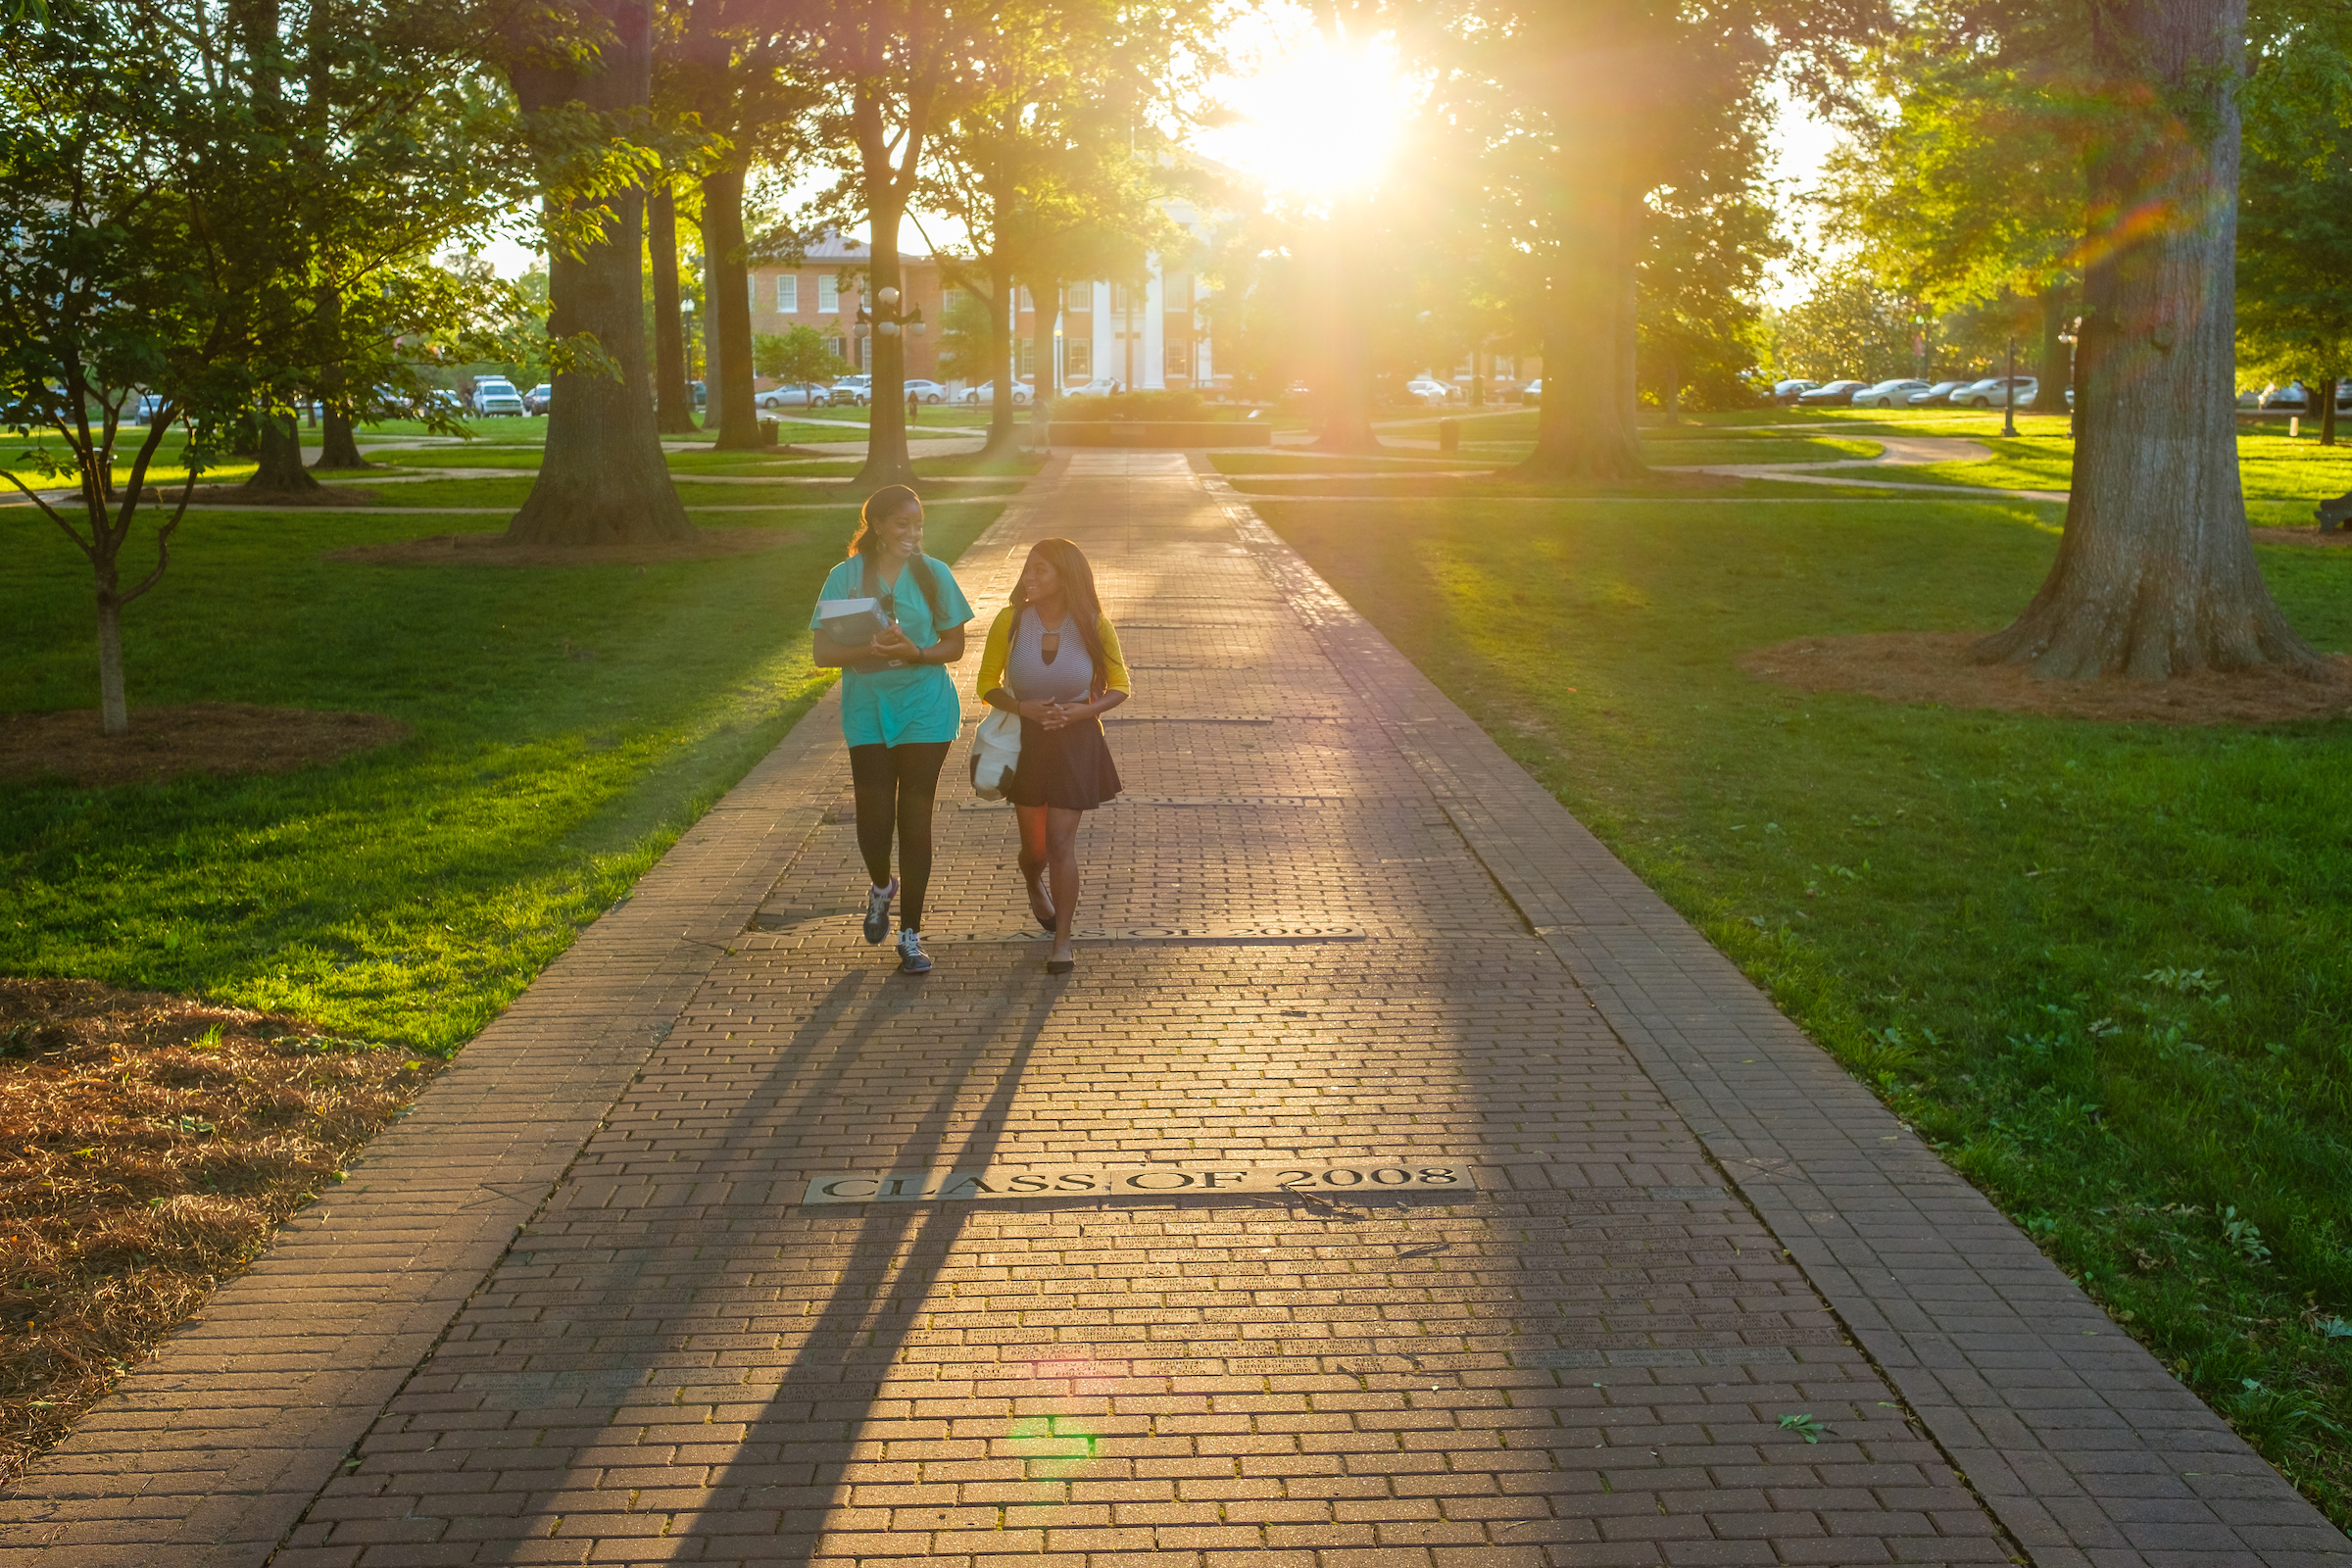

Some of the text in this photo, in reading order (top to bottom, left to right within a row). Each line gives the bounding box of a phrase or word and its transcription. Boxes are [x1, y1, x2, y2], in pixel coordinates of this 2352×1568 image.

[1127, 928, 1210, 937] OF
[1229, 927, 1353, 937] 2009
[821, 1167, 1458, 1198] CLASS OF 2008
